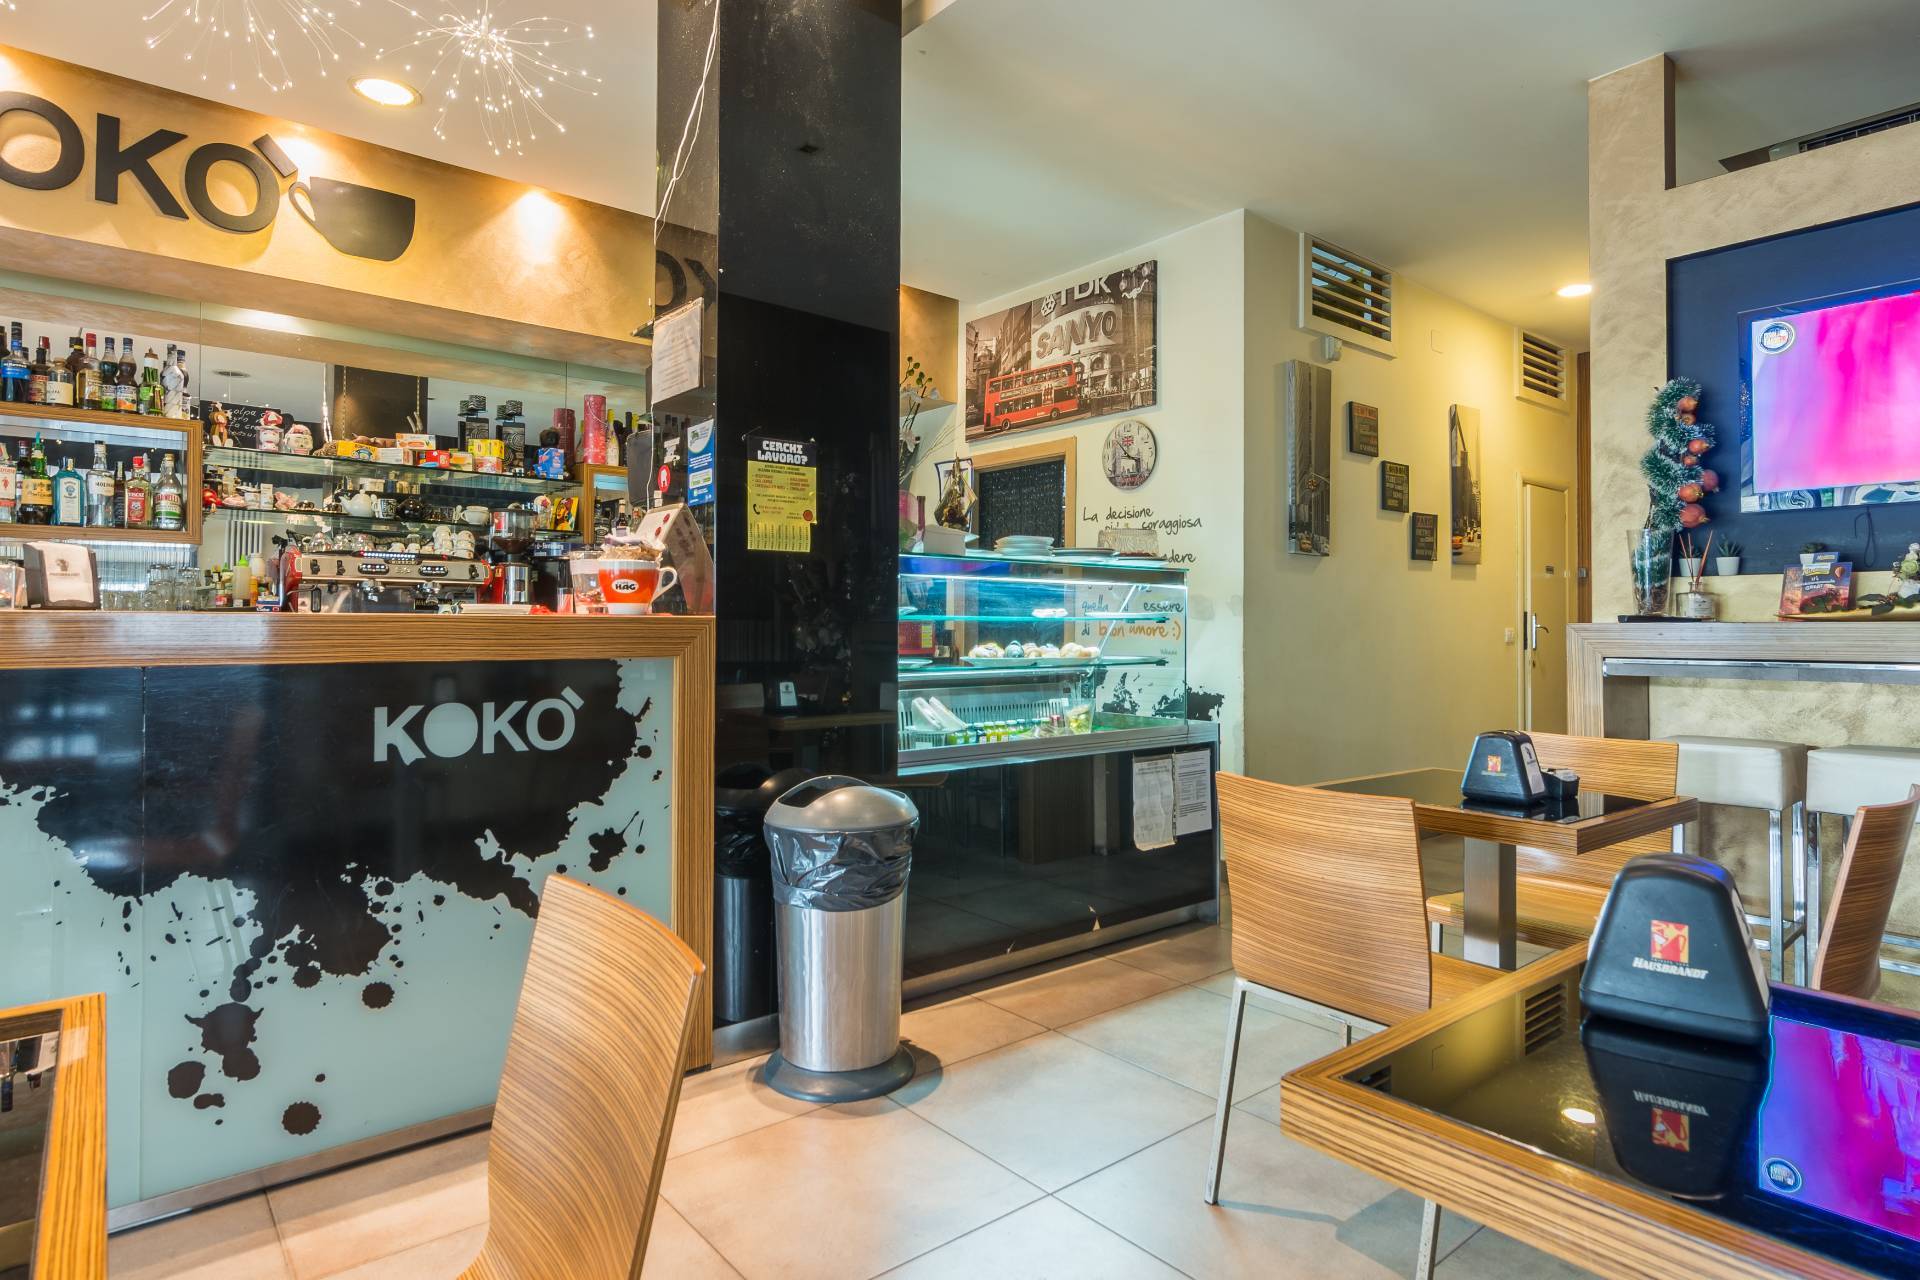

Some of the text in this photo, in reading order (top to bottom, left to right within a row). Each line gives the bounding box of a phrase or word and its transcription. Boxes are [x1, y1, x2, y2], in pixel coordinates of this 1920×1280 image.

[1057, 276, 1111, 306] TDK
[1036, 310, 1117, 359] SANYO
[762, 440, 803, 455] CERCHI
[757, 450, 808, 464] LAVORO?
[1083, 505, 1153, 522] La decisione
[1142, 514, 1202, 535] coraggiosa
[615, 583, 636, 591] HAG
[1143, 602, 1184, 613] essere
[1632, 956, 1709, 980] HAUSBRANDT
